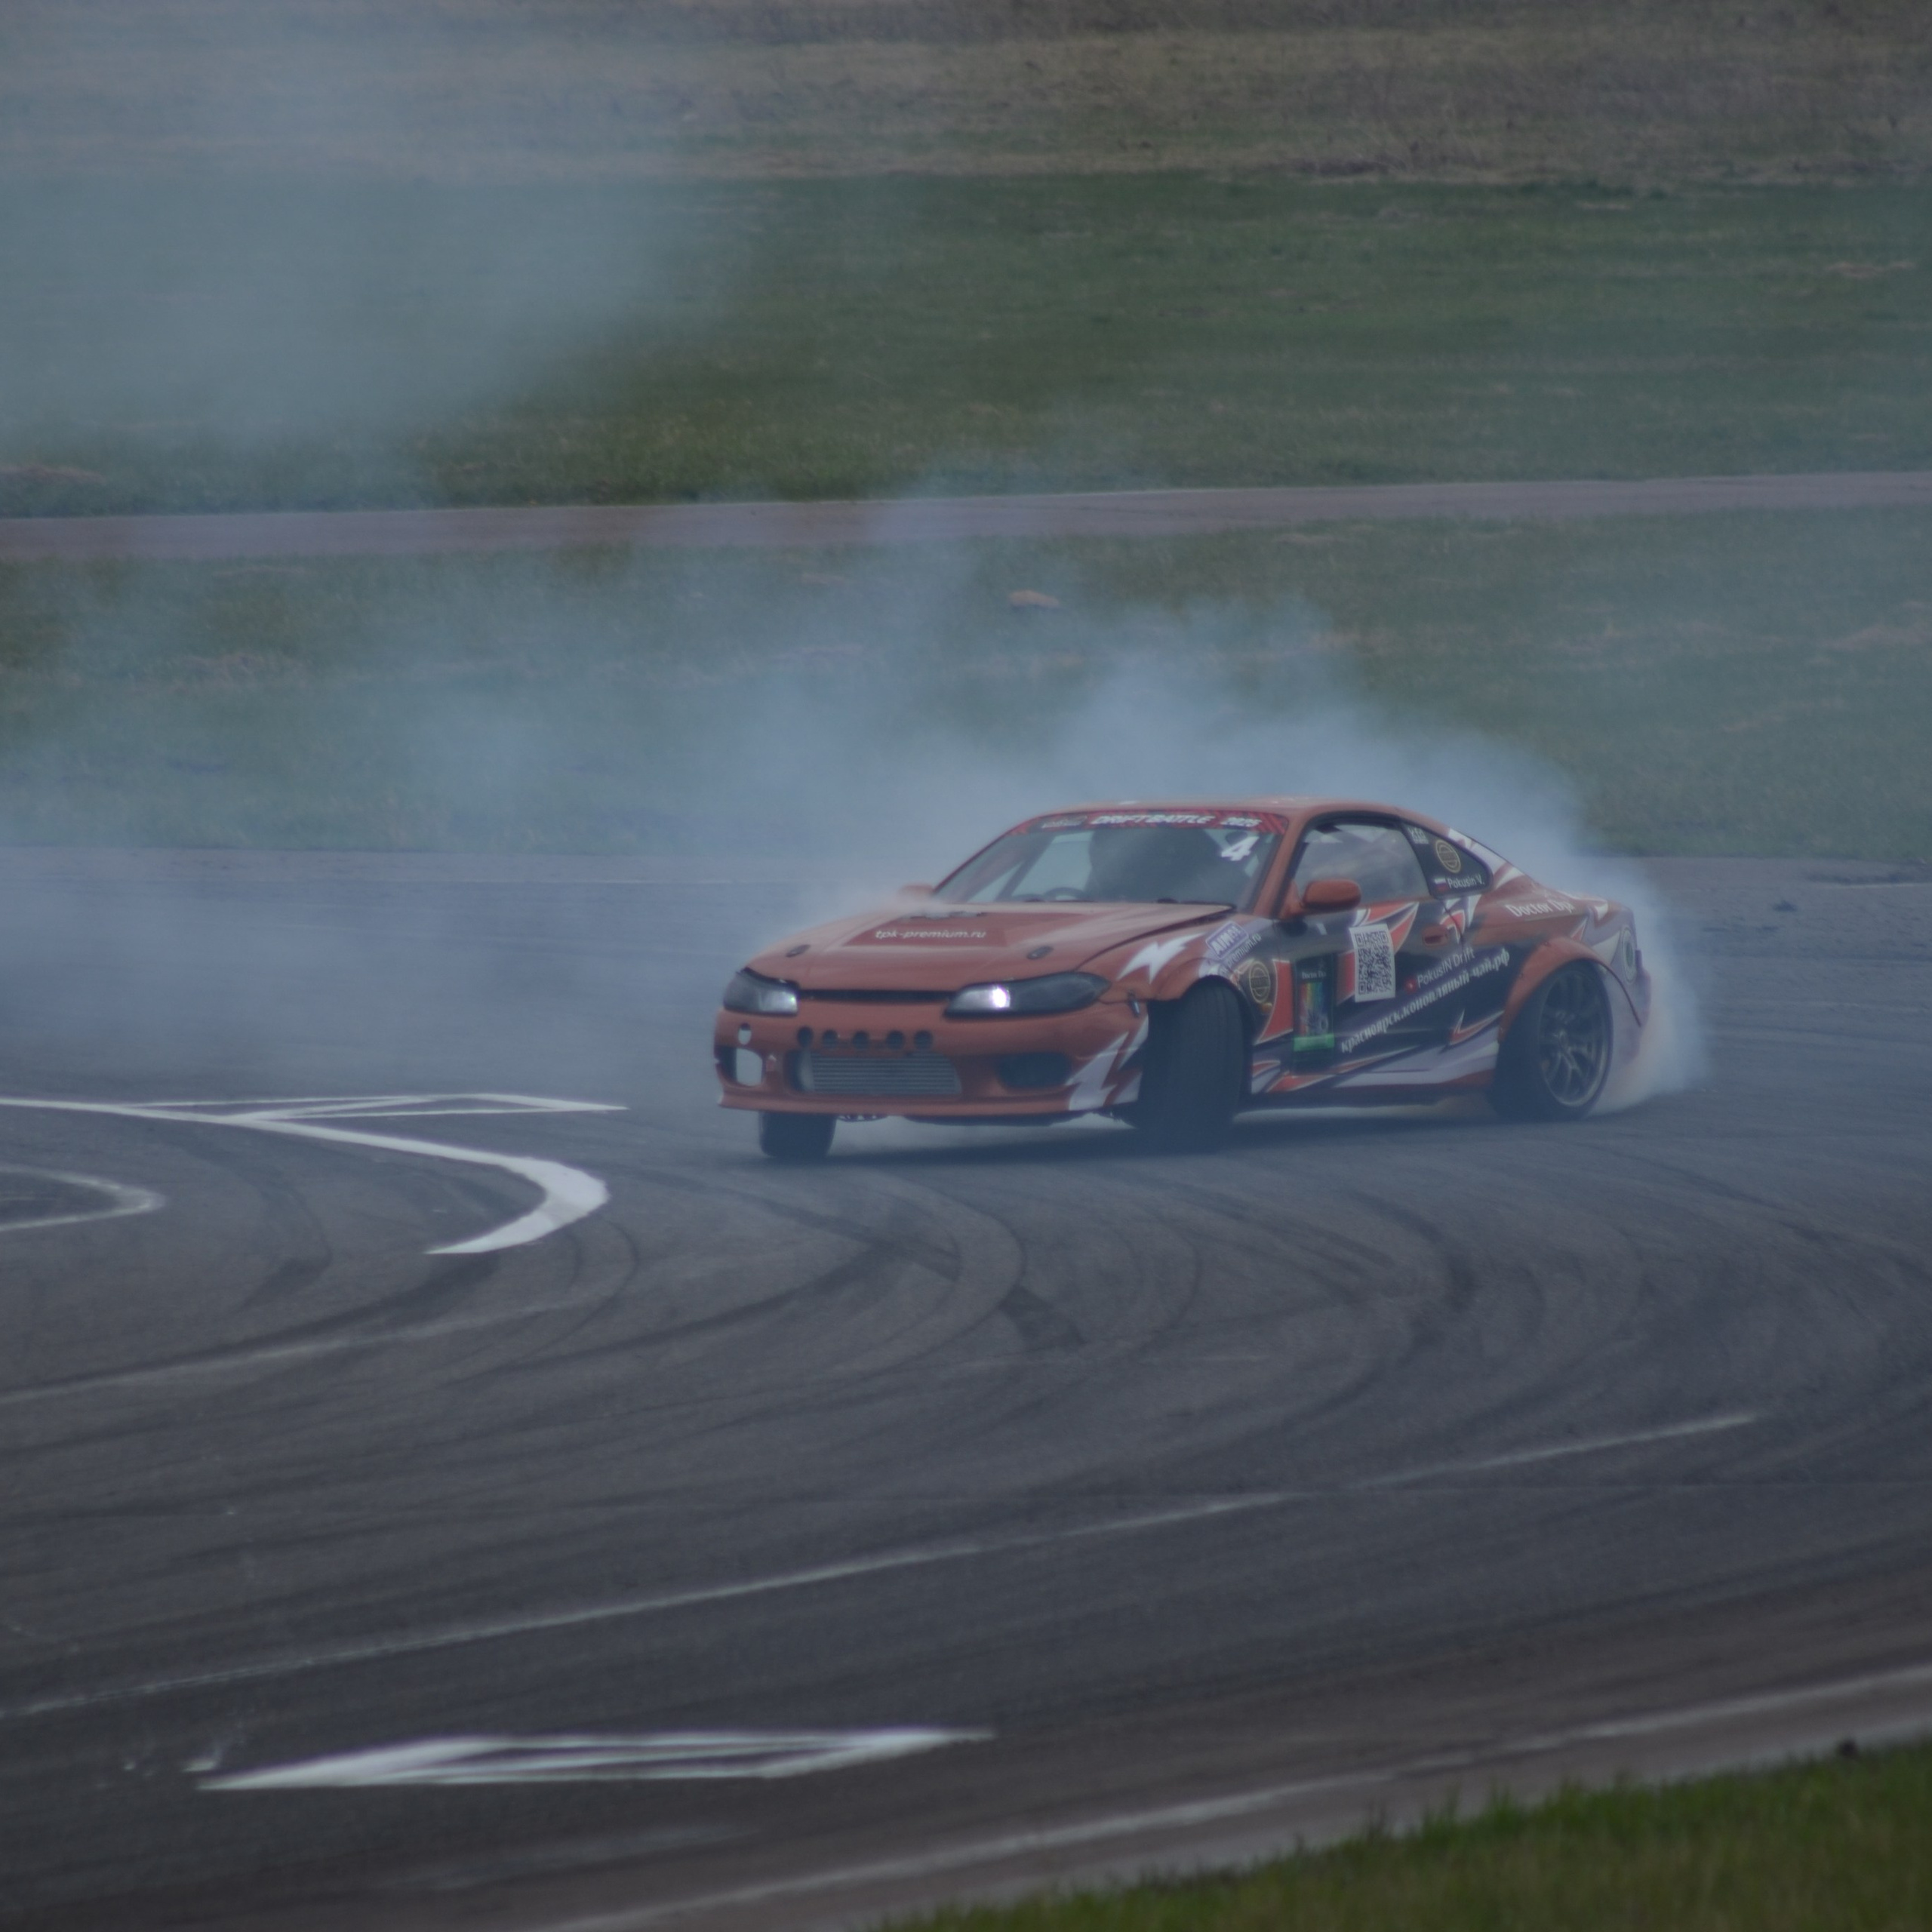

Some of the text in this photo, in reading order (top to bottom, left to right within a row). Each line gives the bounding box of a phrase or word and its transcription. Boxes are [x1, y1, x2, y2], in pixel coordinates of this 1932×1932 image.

[1221, 835, 1260, 862] 4
[1505, 903, 1553, 917] Doctor
[875, 929, 986, 940] tpk-premium.ru
[1453, 946, 1476, 968] Drift
